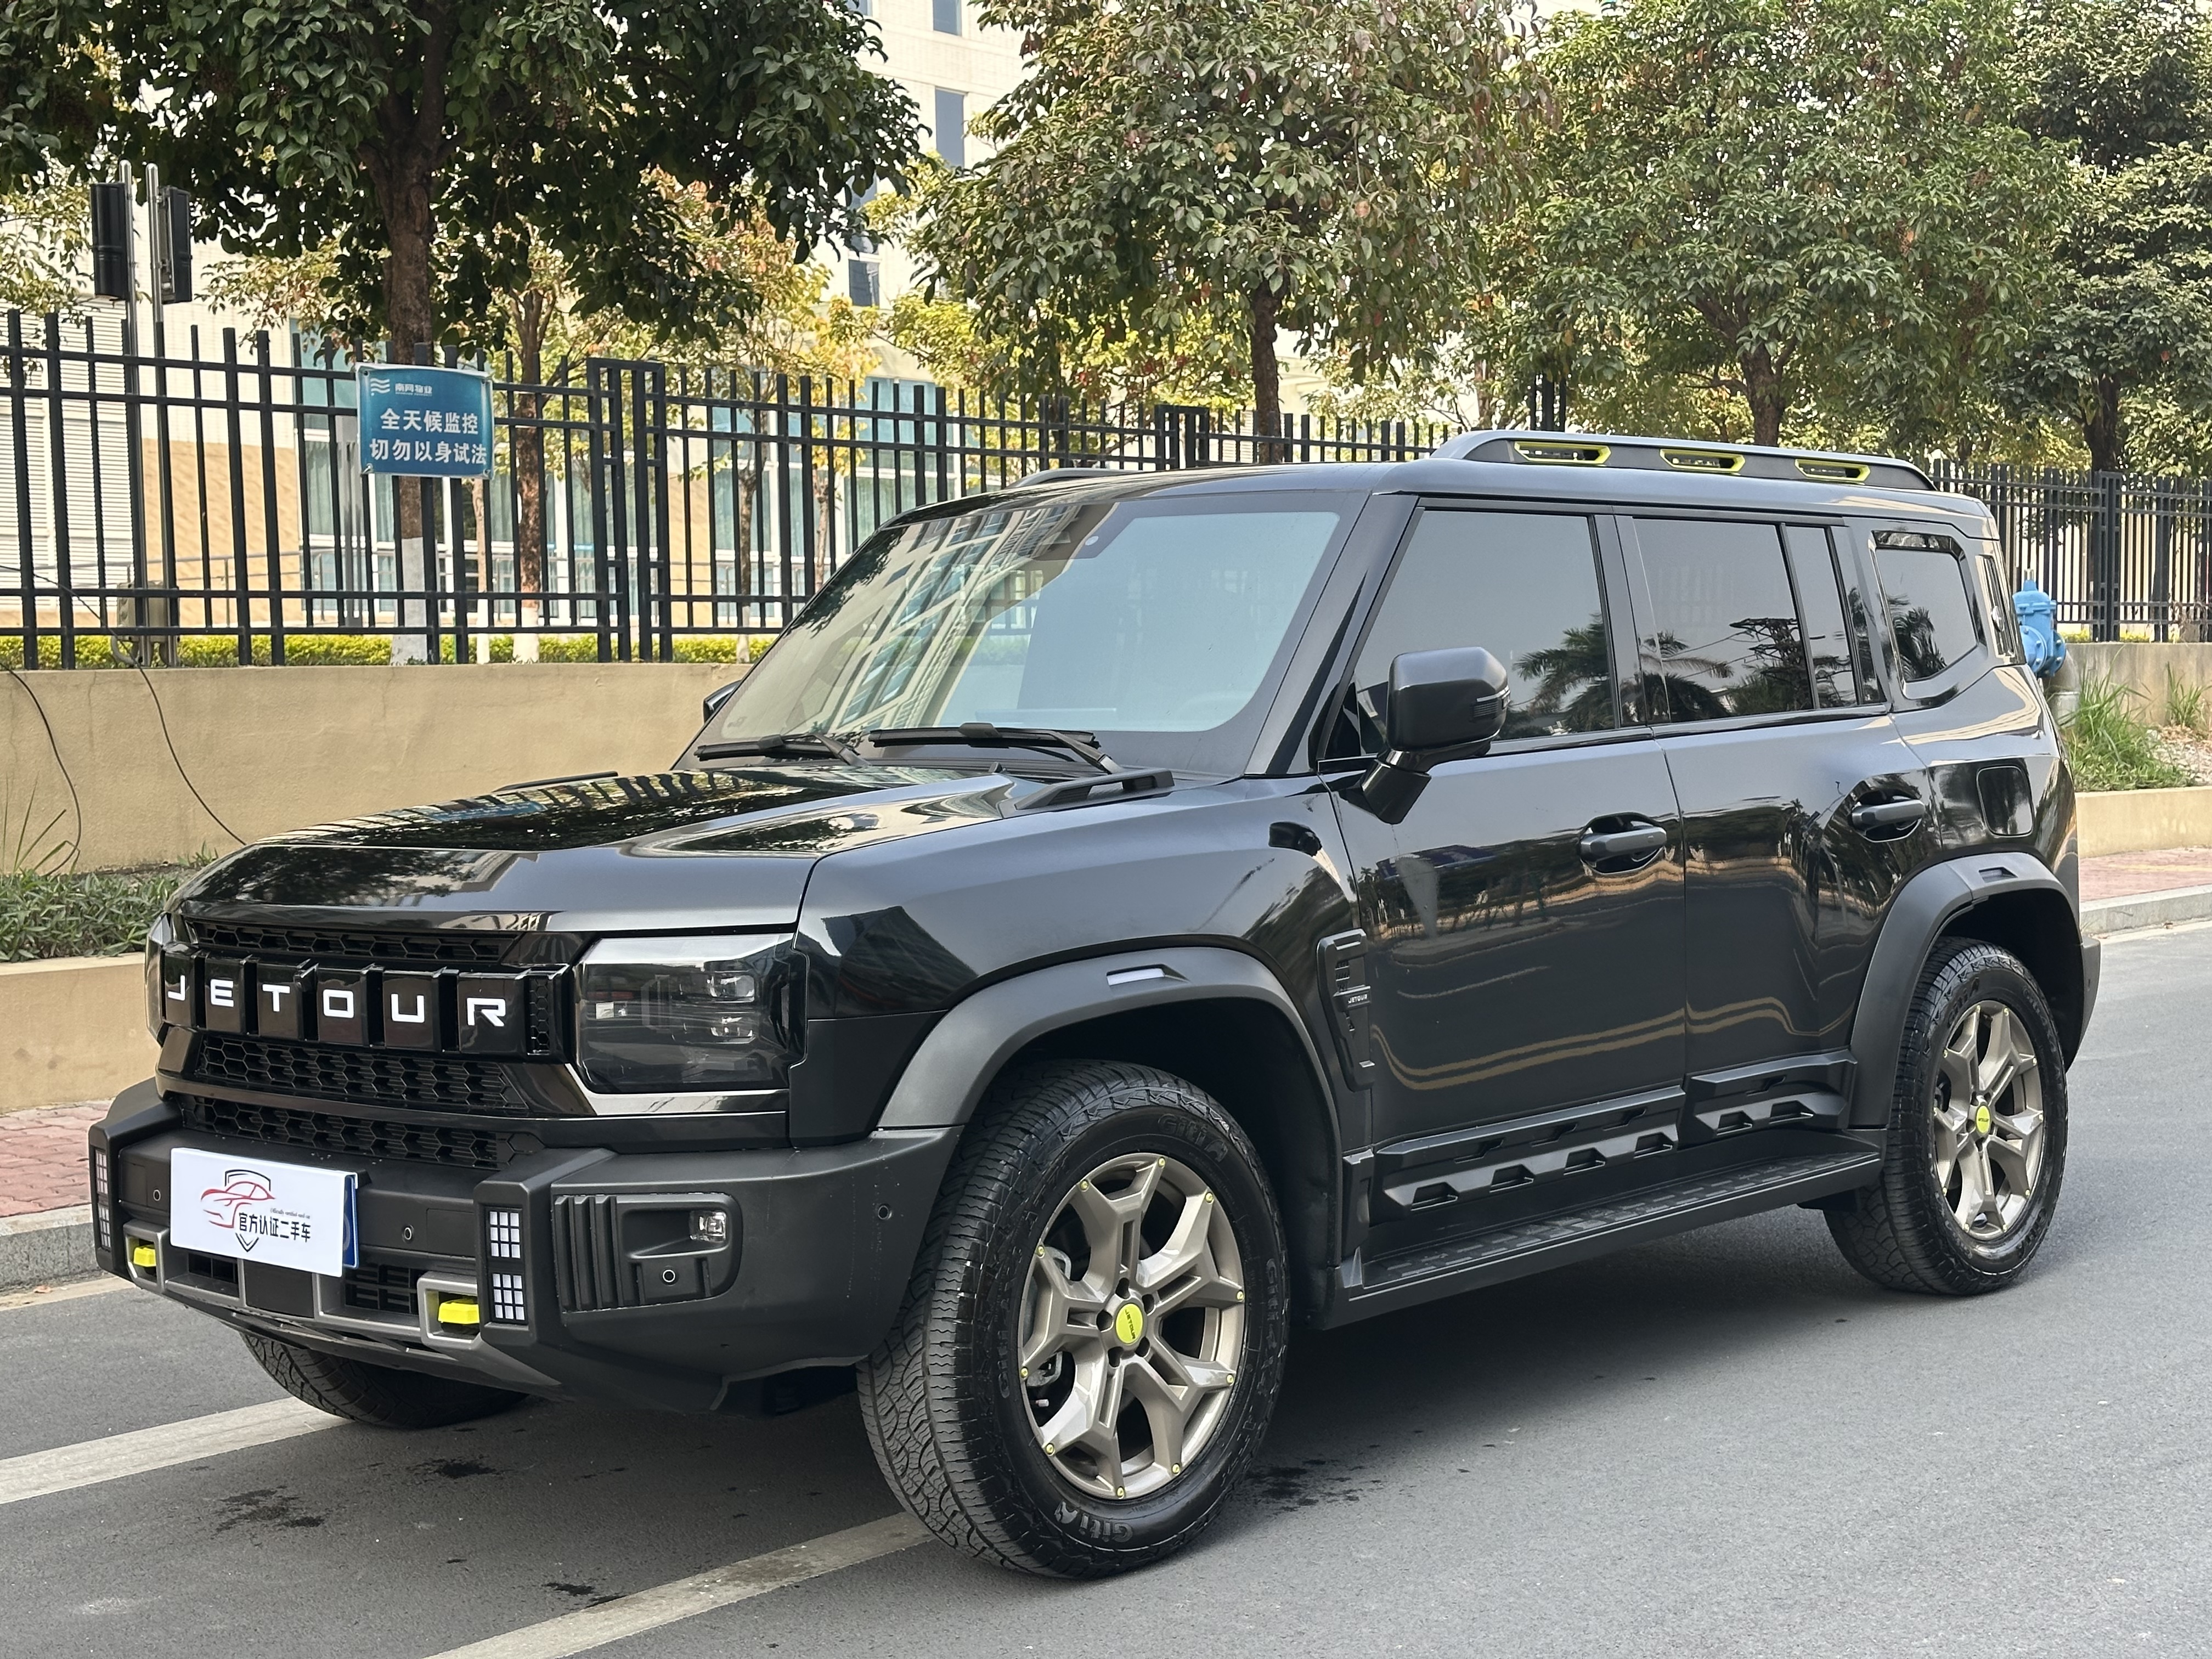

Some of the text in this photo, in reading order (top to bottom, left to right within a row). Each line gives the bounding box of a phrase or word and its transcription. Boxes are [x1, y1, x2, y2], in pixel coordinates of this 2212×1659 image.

[380, 408, 478, 435] 全天候监控
[369, 439, 487, 465] 切勿以身试法
[168, 975, 506, 1026] JETOUR
[1348, 994, 1368, 1003] JETOUR
[1158, 1113, 1208, 1146] Giti
[239, 1212, 311, 1242] 官方认证二手车
[1125, 1309, 1136, 1339] JETOUR
[1078, 1514, 1132, 1543] Giti
